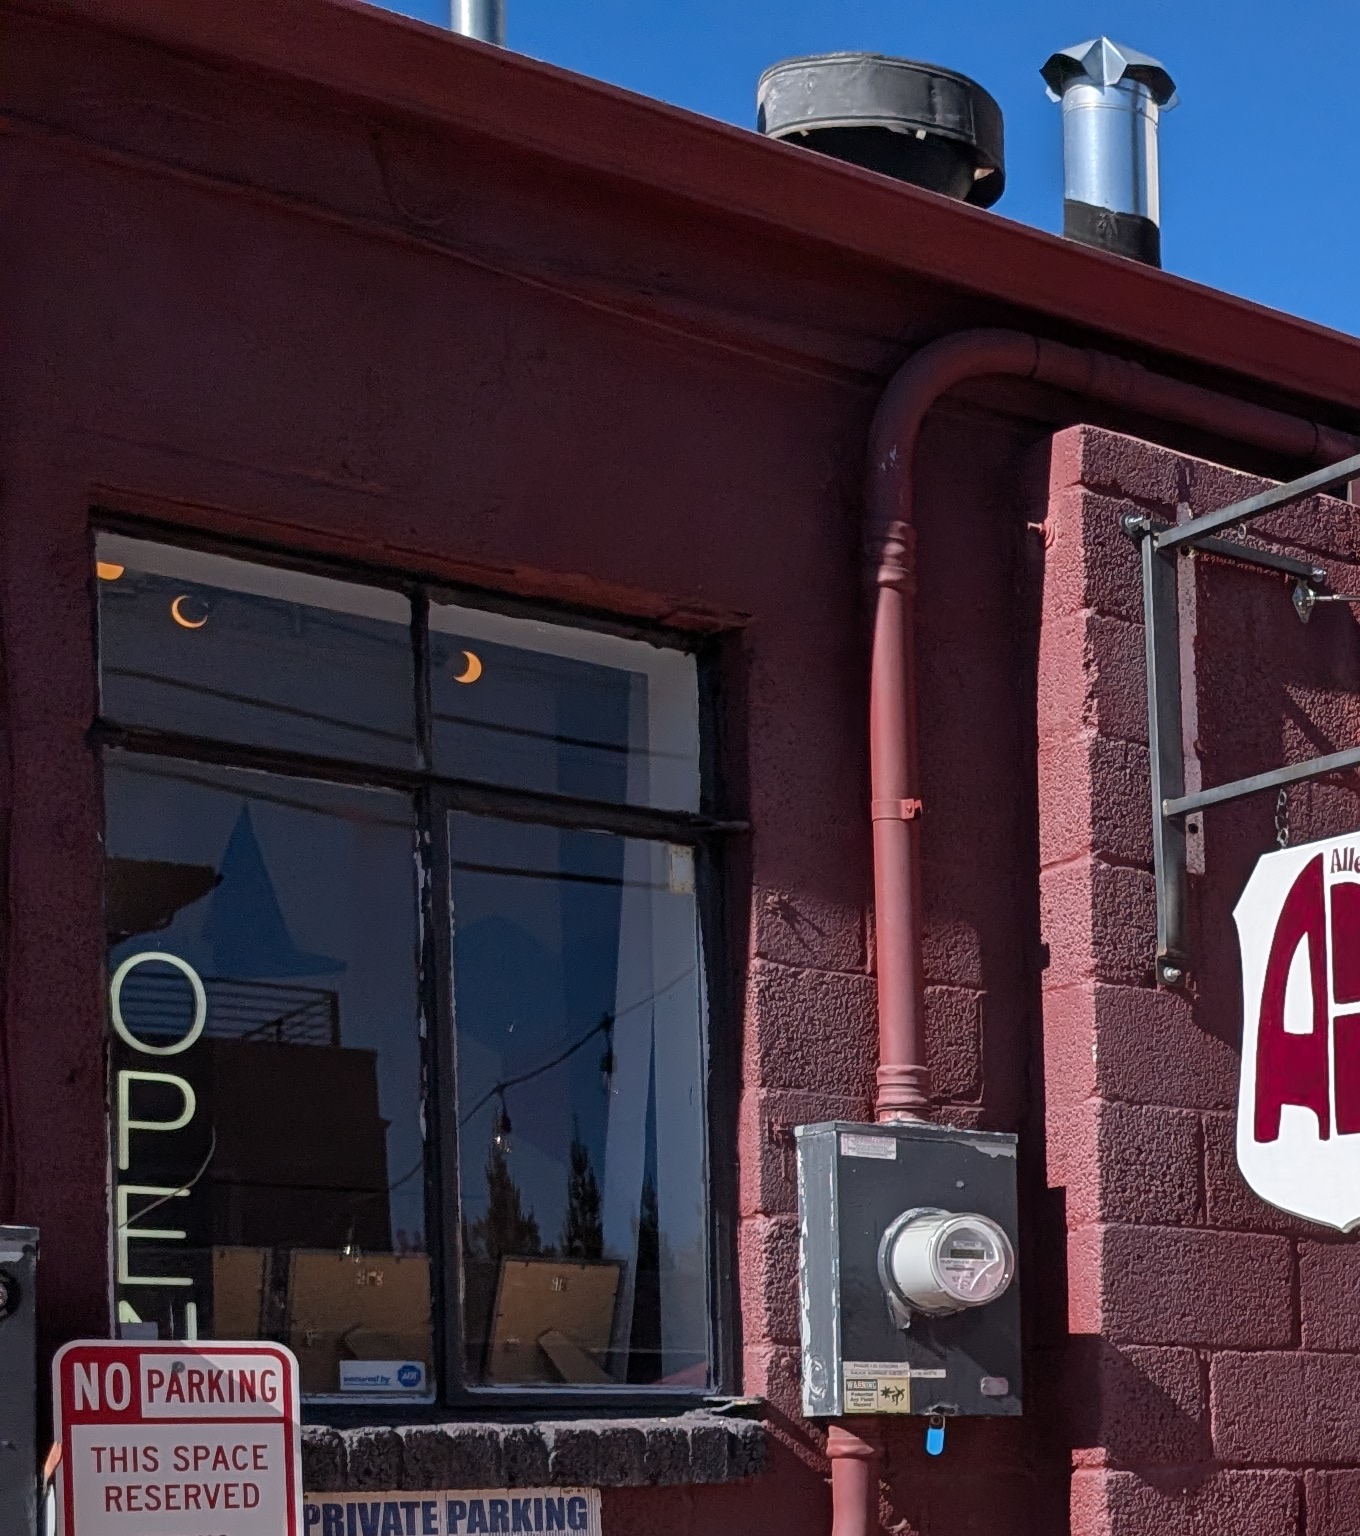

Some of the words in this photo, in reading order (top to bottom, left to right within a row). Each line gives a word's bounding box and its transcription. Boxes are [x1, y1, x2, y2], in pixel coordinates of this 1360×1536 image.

[73, 1362, 132, 1411] NO
[147, 1368, 278, 1404] PARKING
[91, 1446, 159, 1473] THIS
[173, 1444, 269, 1472] SPACE
[105, 1483, 260, 1512] RESERVED
[447, 1496, 588, 1535] PARKING
